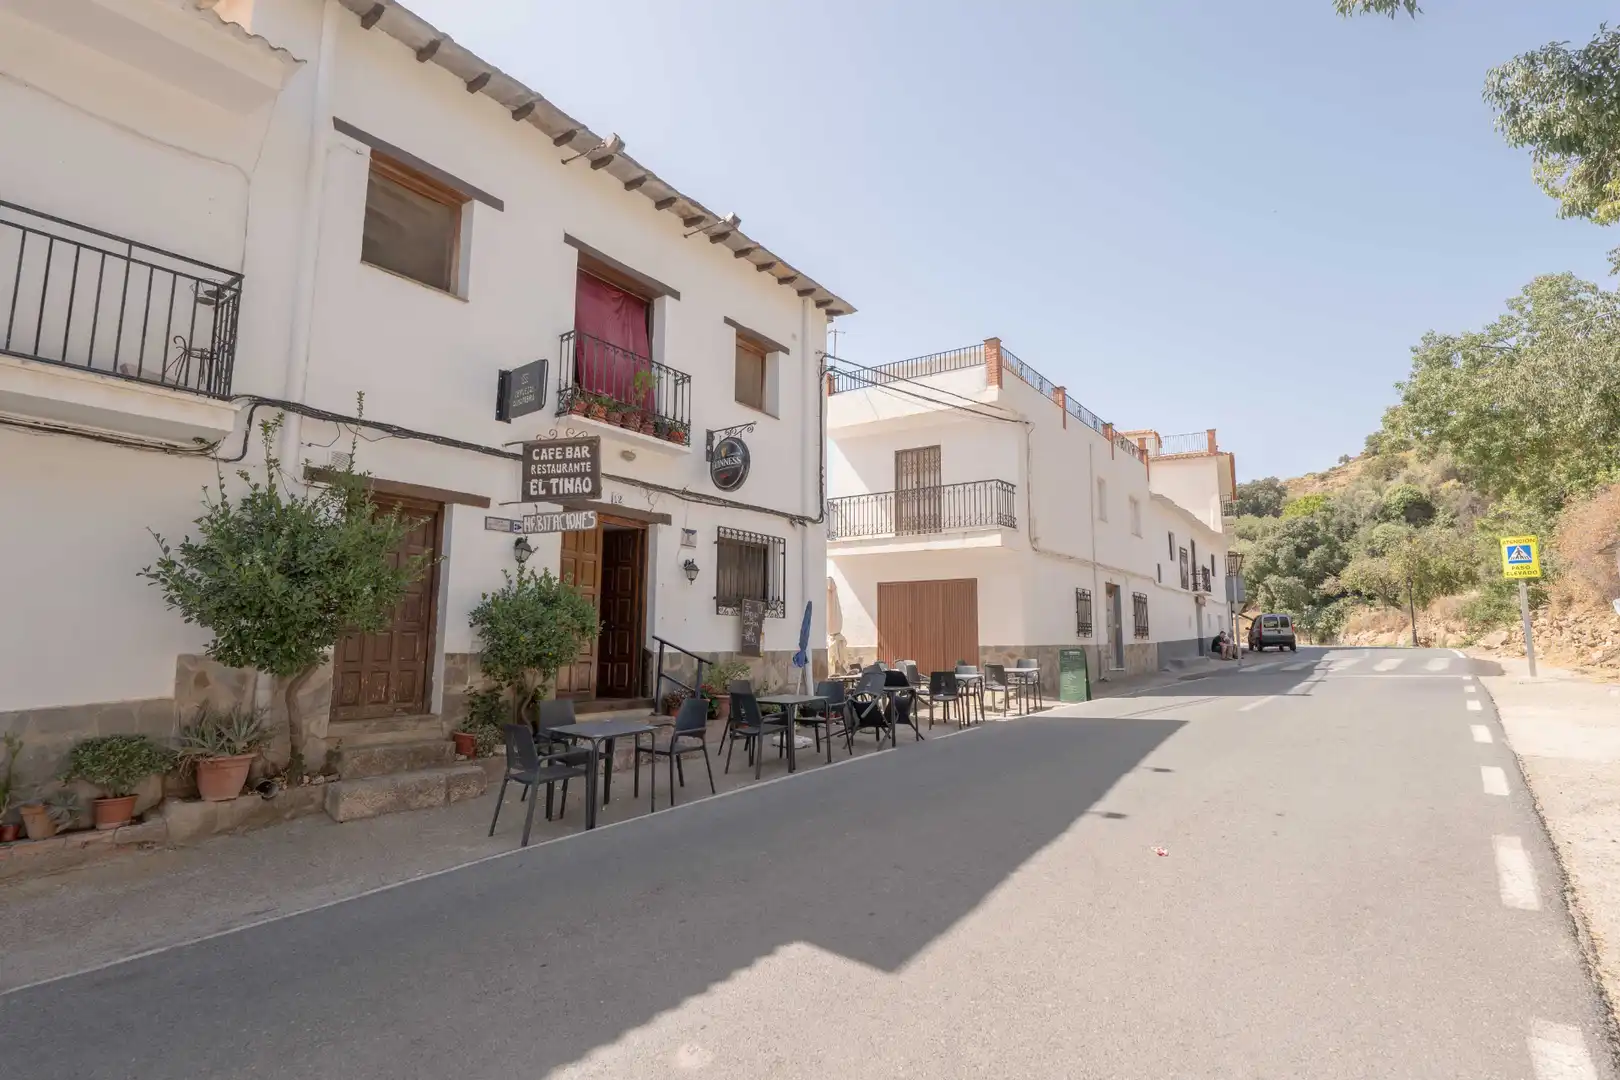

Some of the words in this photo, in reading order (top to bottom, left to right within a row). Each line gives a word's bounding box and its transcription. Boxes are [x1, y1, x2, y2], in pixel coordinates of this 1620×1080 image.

[530, 462, 592, 475] RESTAURANTE
[530, 478, 546, 495] EL
[549, 476, 592, 495] TINAO
